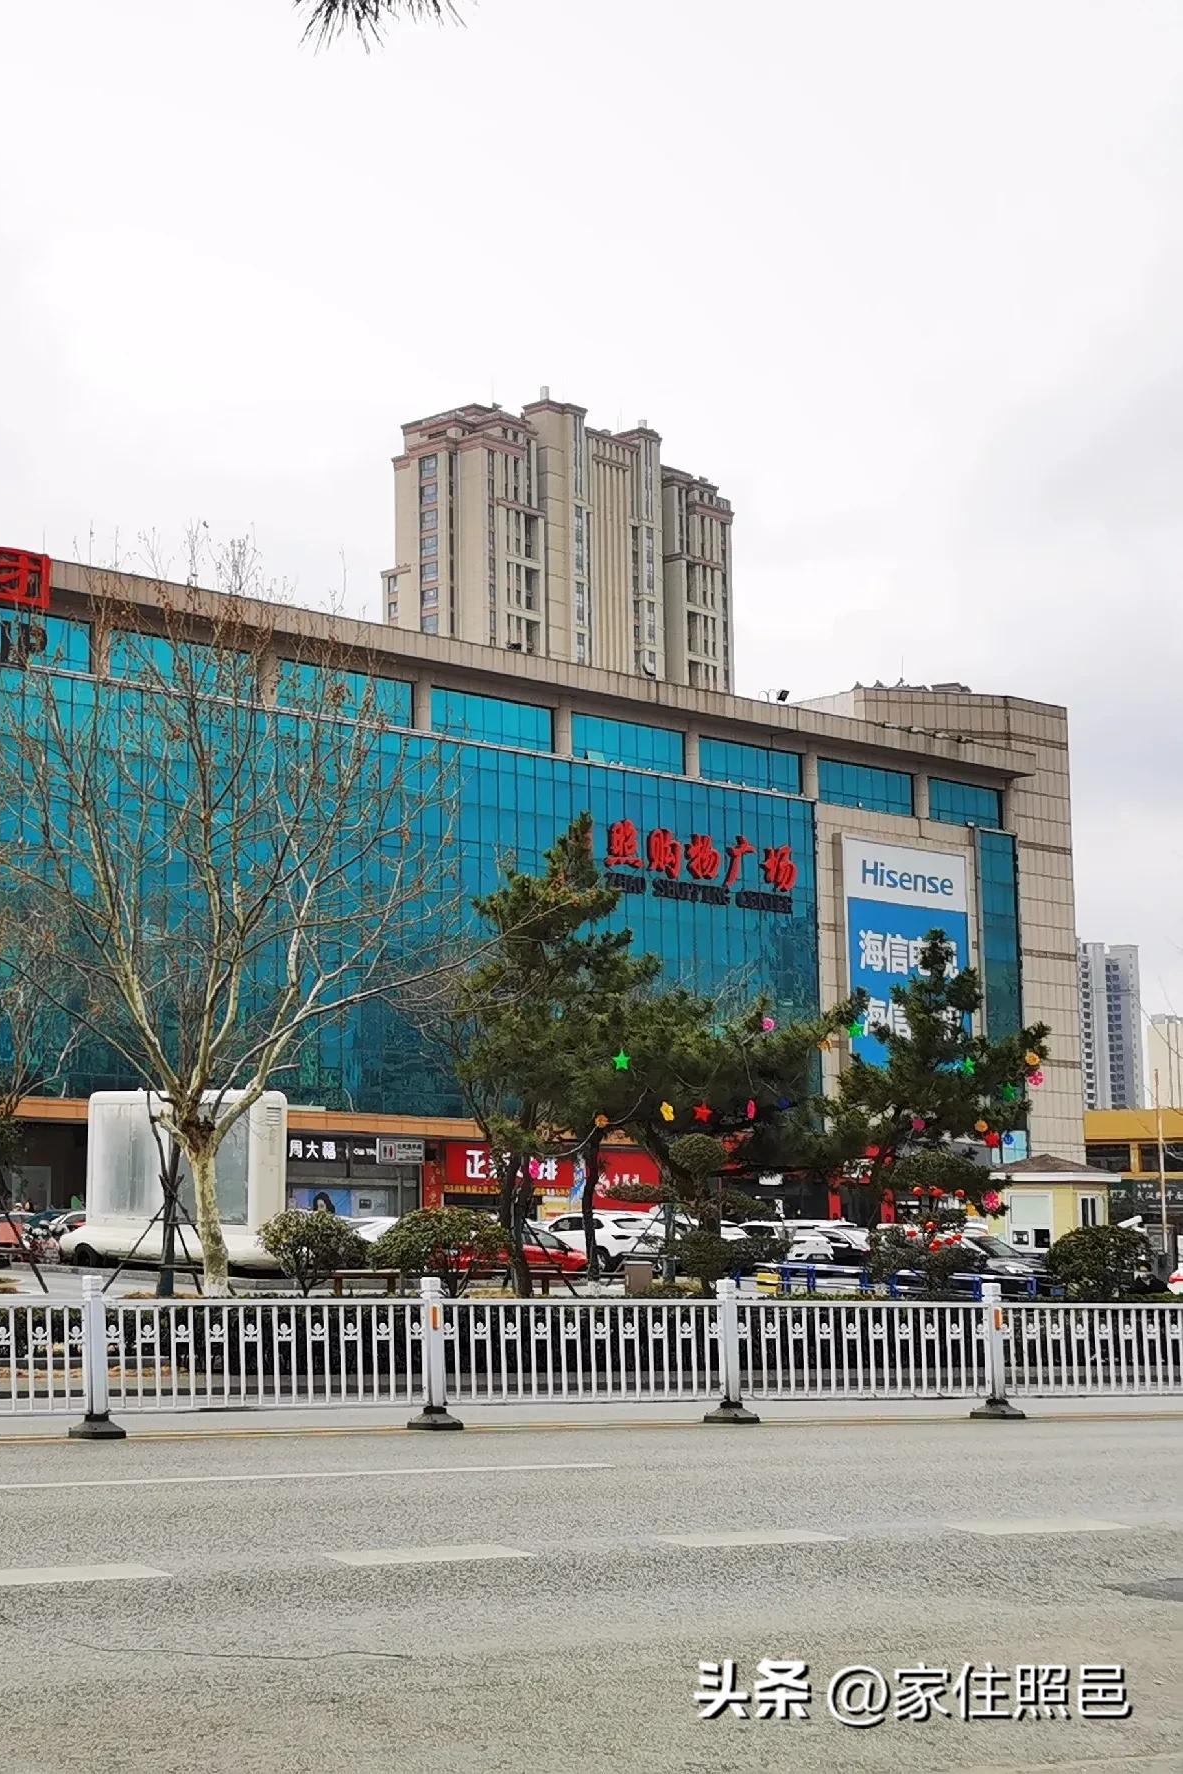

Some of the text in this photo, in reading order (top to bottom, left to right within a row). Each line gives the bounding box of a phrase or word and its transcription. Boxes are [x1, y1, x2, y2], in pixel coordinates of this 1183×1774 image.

[584, 818, 798, 892] 照购物广场
[862, 859, 954, 896] Hisense
[289, 1139, 337, 1160] 周大福
